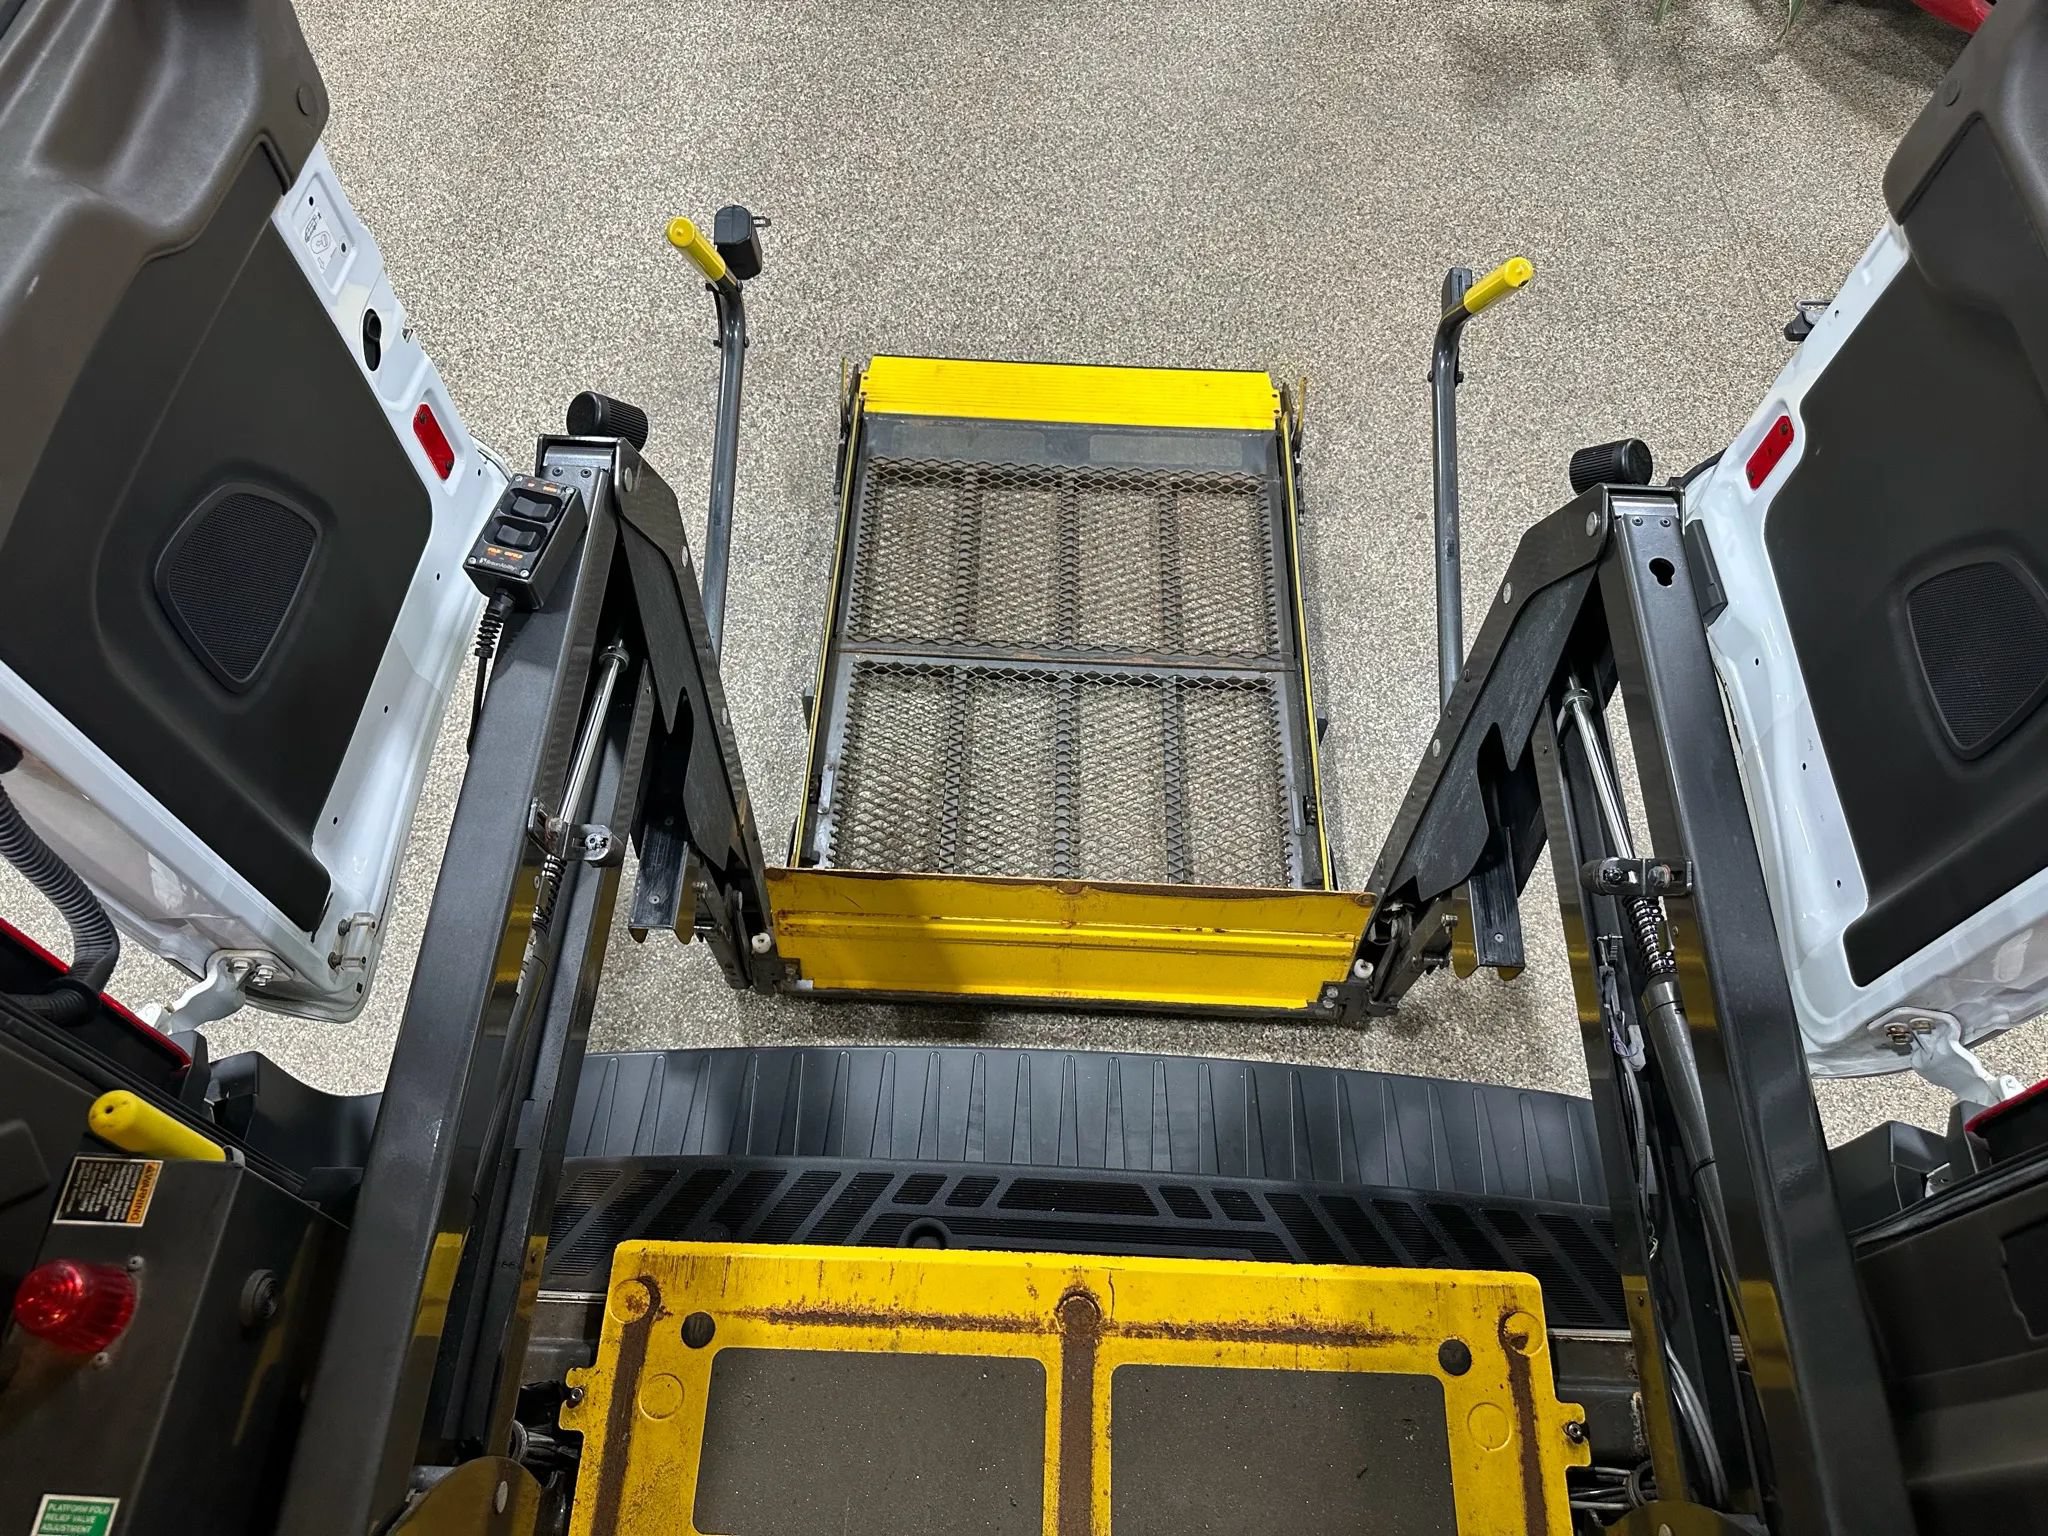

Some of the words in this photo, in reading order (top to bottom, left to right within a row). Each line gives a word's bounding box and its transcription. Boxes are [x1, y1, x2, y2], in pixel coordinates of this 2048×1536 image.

[131, 1170, 153, 1219] WARNING
[48, 1503, 88, 1513] PLATFORM
[73, 1515, 97, 1523] VALVE
[41, 1523, 93, 1533] ADJUSTMENT
